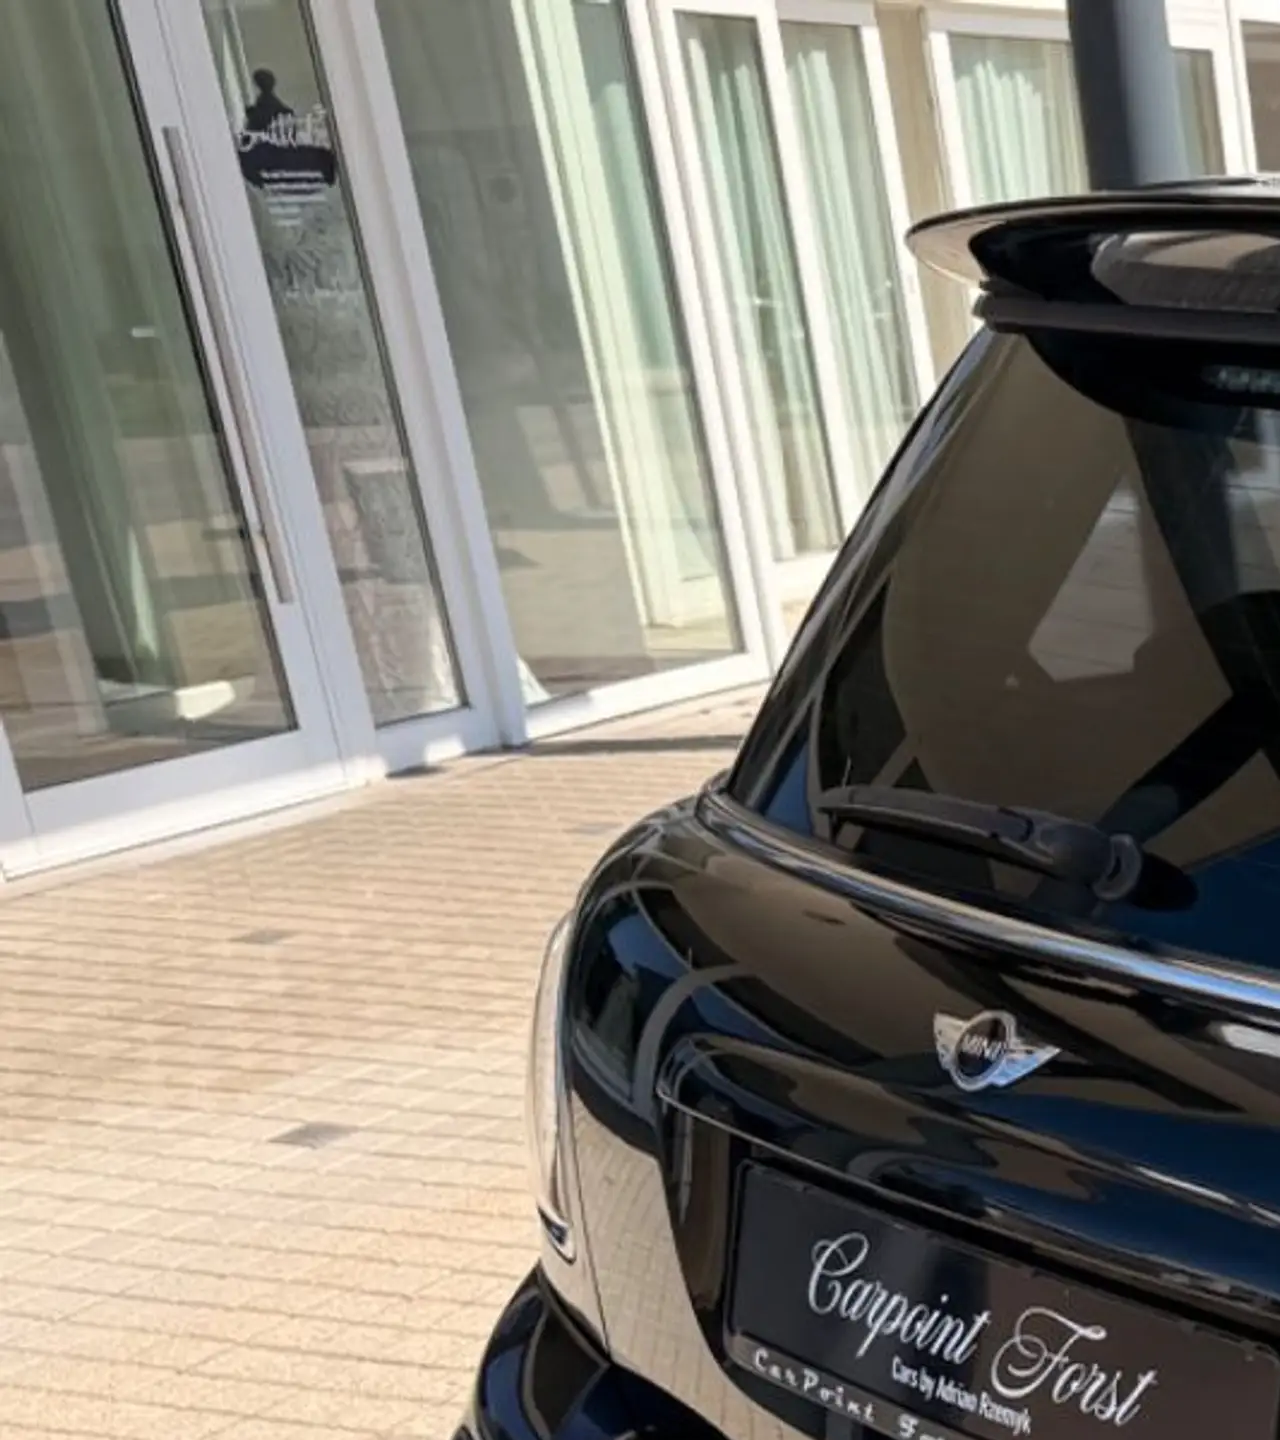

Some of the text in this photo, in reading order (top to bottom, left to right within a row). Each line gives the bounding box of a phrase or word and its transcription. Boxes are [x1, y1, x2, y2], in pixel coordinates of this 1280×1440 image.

[808, 1232, 1157, 1427] Carpoint Forst
[892, 1354, 918, 1388] Cars
[919, 1366, 936, 1402] by
